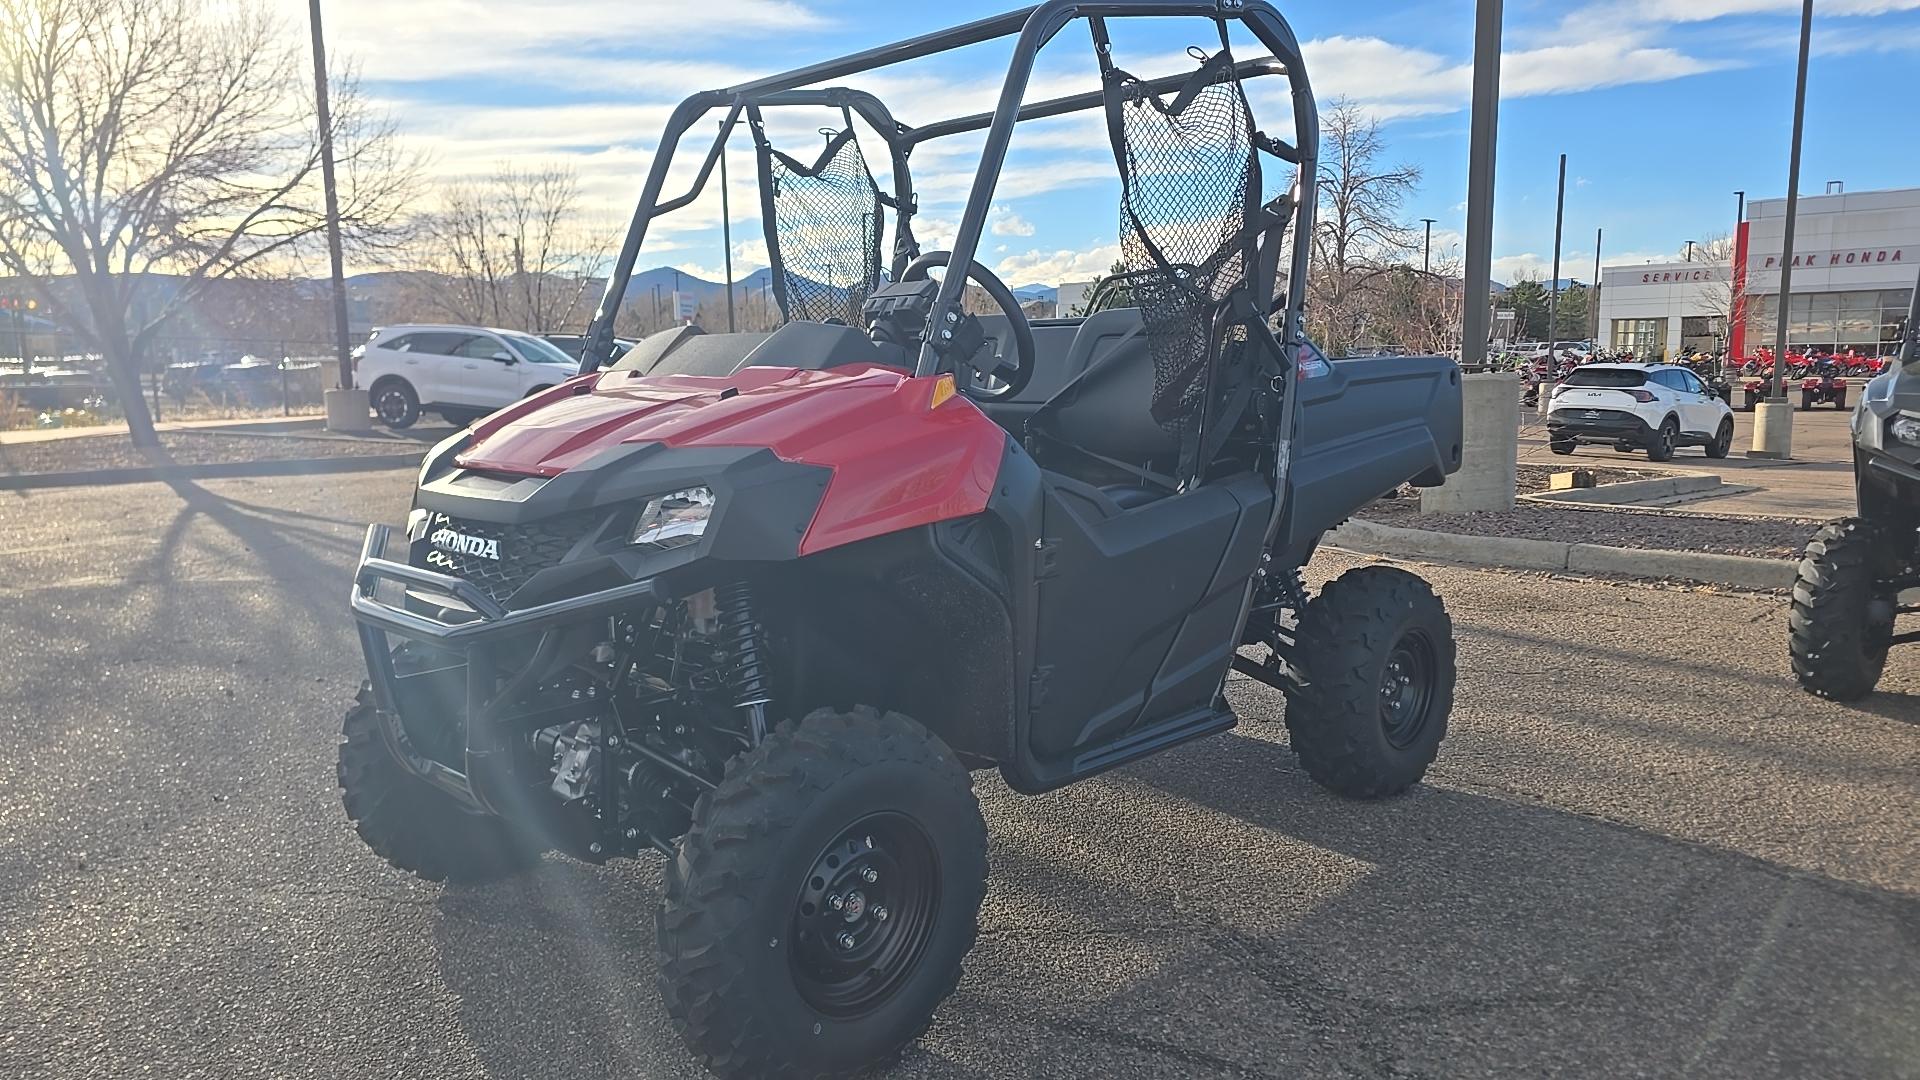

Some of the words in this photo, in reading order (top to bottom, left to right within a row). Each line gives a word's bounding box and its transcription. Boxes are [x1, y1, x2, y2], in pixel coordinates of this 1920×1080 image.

[1765, 254, 1816, 267] PAK
[1830, 250, 1901, 264] HONDA
[1642, 271, 1711, 282] SERVICE
[433, 528, 499, 560] HONDA
